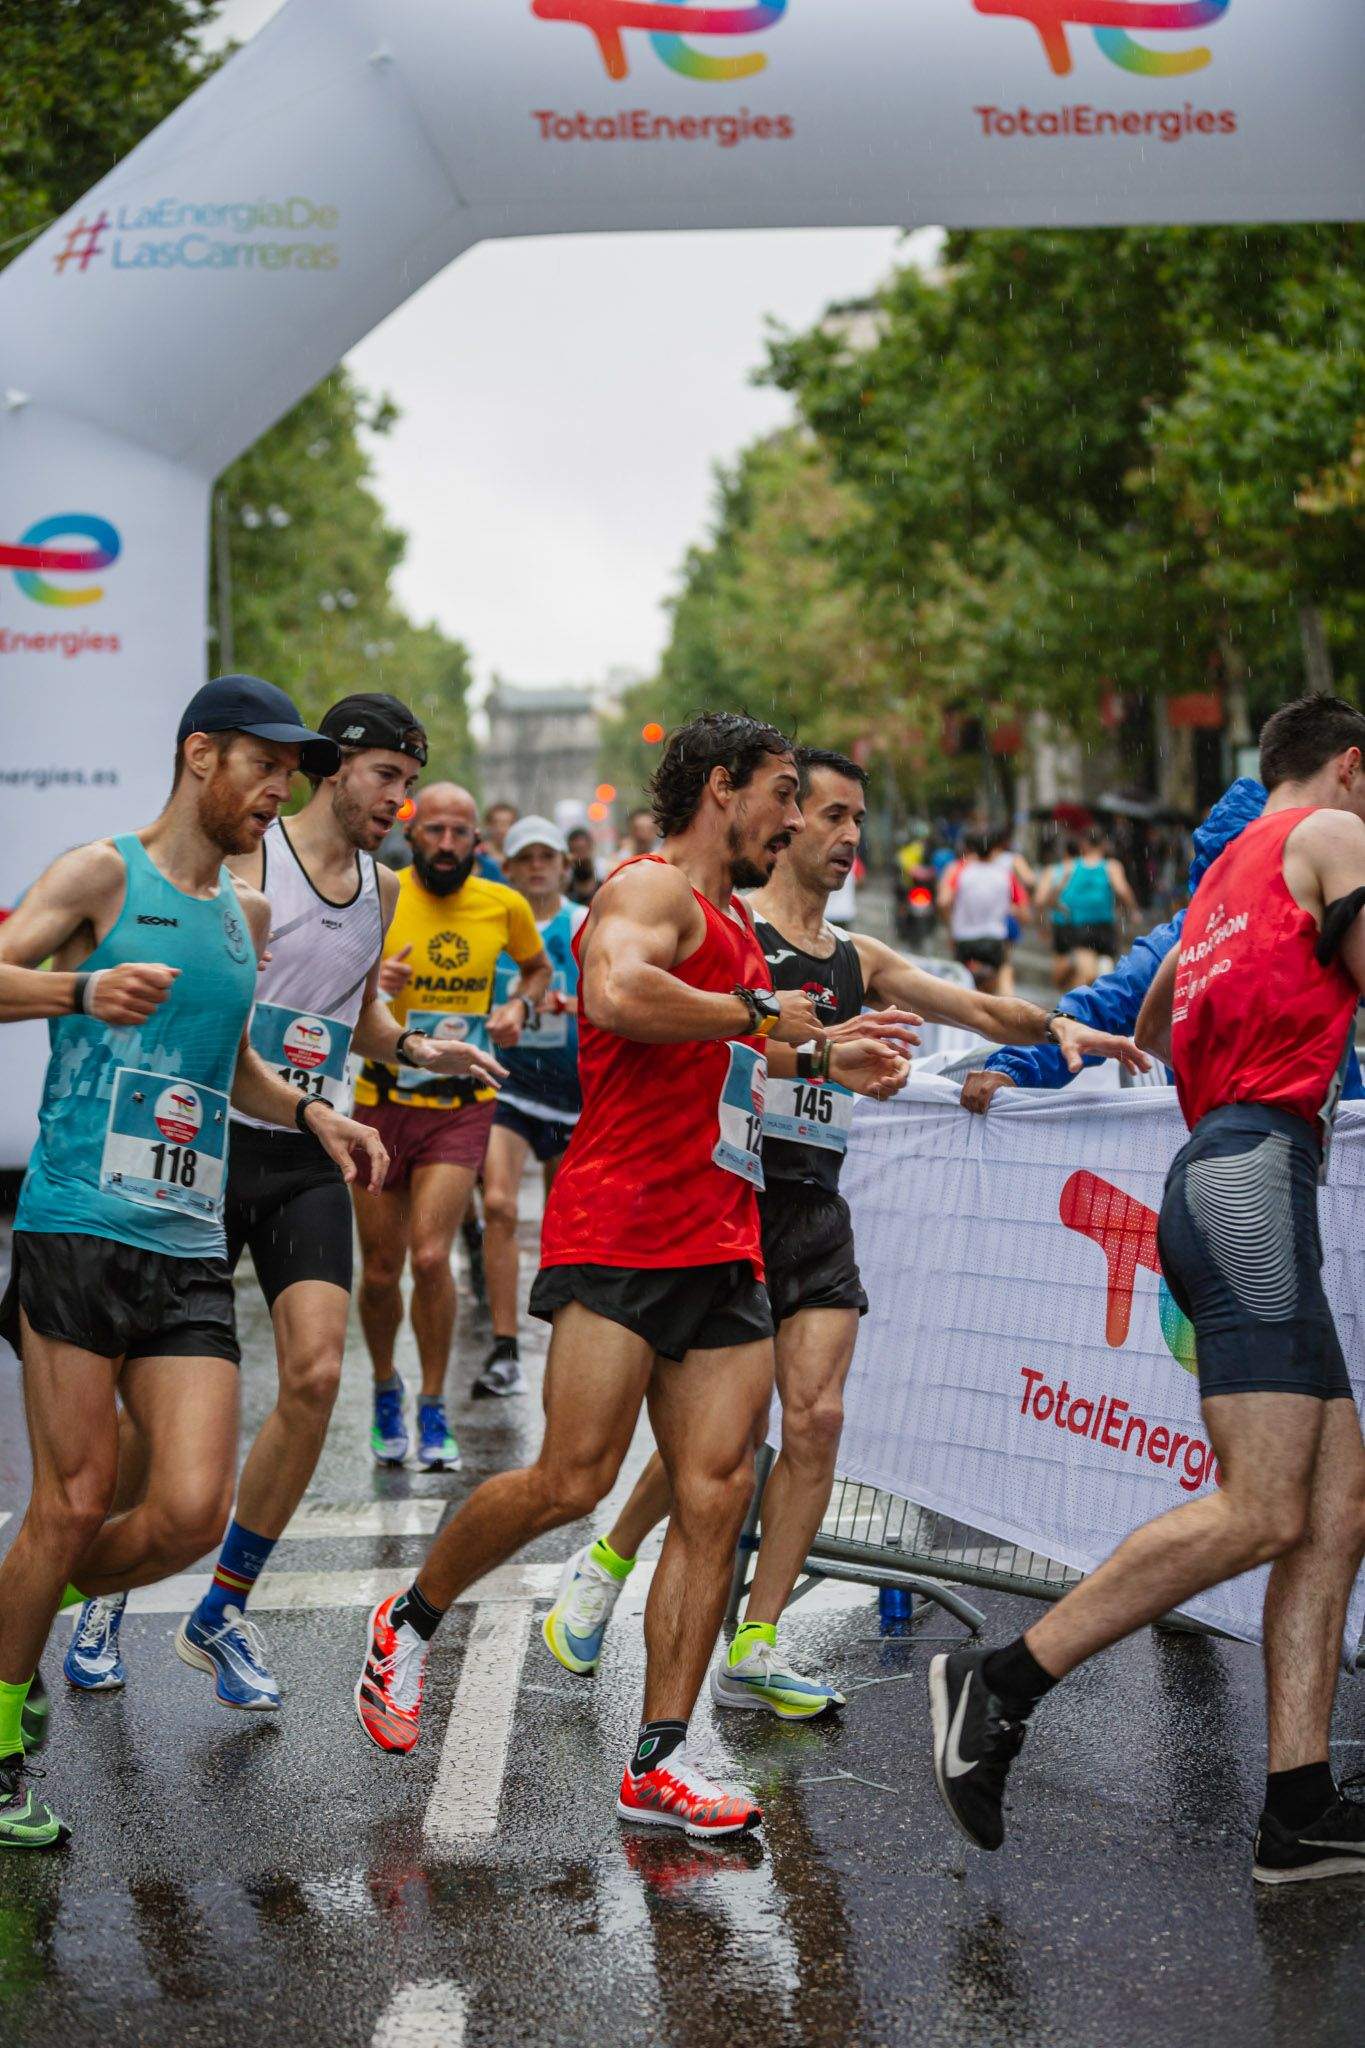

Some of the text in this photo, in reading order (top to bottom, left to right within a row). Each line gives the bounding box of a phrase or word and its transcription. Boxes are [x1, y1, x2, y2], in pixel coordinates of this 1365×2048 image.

[530, 105, 795, 148] TotalEnergies
[972, 101, 1238, 143] TotalEnergies
[793, 1084, 833, 1124] 145
[151, 1142, 197, 1188] 118
